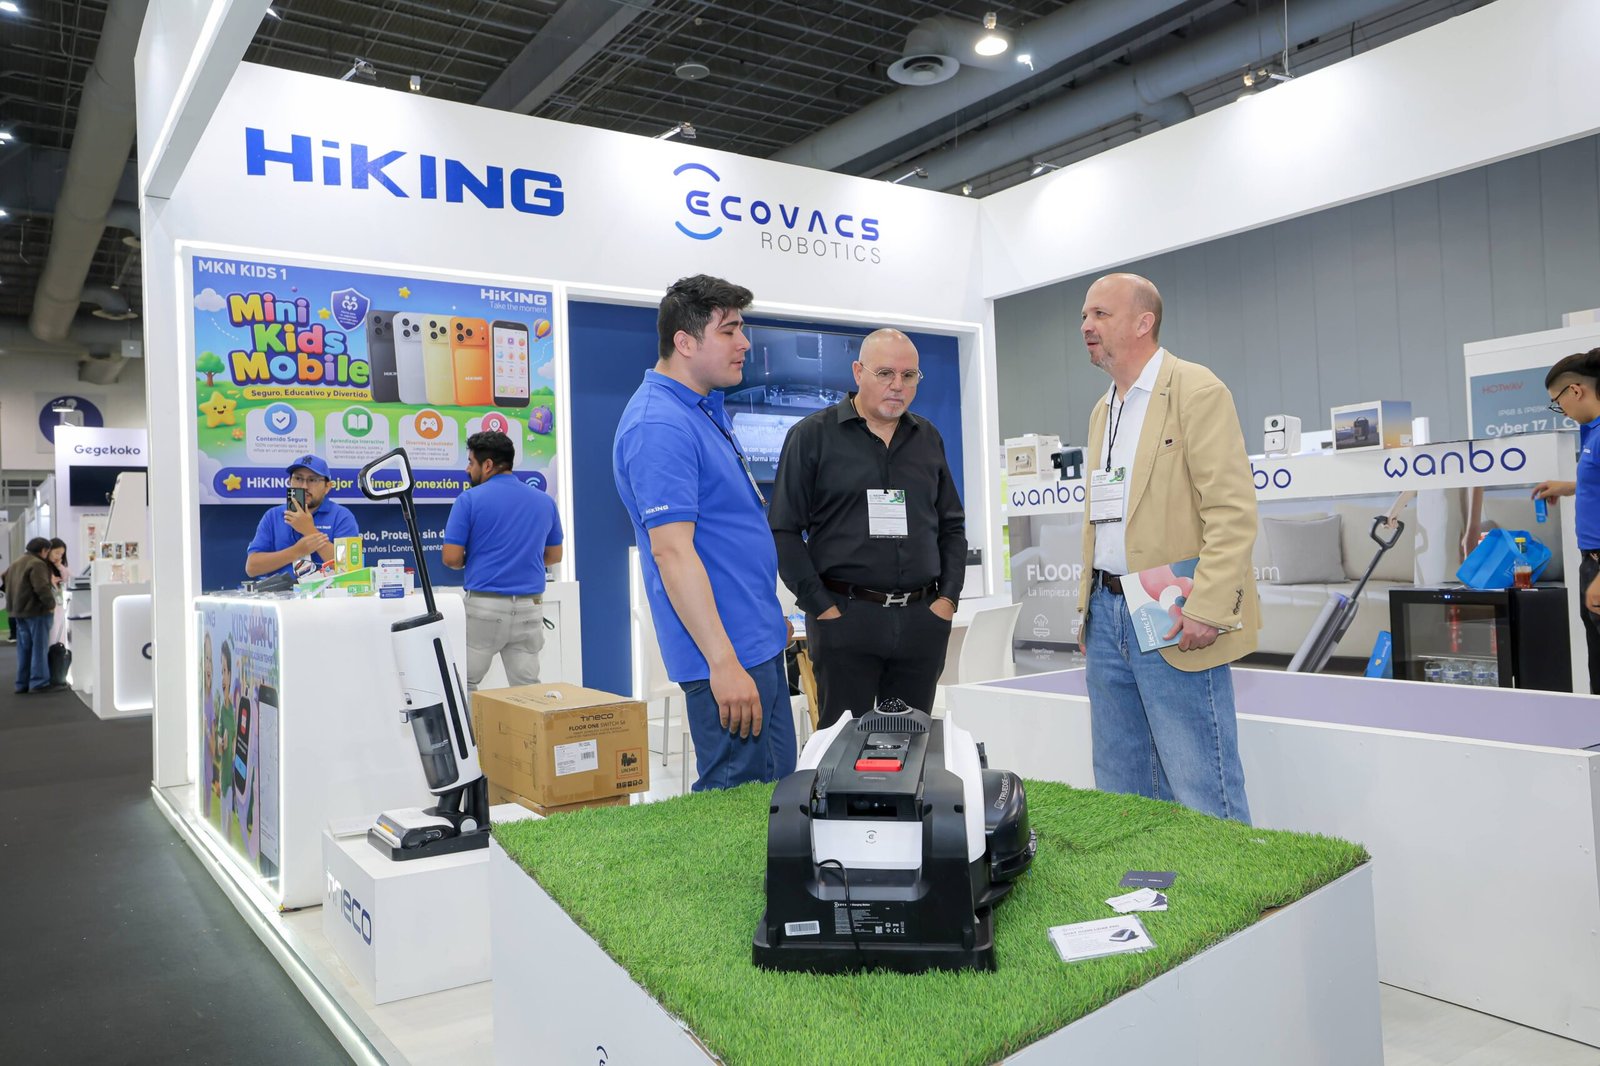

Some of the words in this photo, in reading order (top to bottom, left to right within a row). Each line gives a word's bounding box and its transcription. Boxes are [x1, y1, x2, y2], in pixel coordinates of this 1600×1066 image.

[686, 190, 880, 242] ECOVACS
[761, 231, 881, 264] ROBOTICS
[198, 260, 236, 275] MKN
[240, 265, 277, 279] KIDS
[280, 269, 287, 280] 1
[229, 292, 308, 324] Mini
[490, 301, 507, 310] Take
[507, 303, 519, 311] the
[519, 305, 547, 314] moment
[253, 323, 346, 354] Kids
[231, 351, 370, 384] Mobile
[285, 389, 325, 397] Educativo
[327, 390, 332, 398] y
[334, 389, 368, 398] Divertido
[1485, 422, 1529, 438] Cyber
[1531, 419, 1547, 431] 17
[74, 444, 141, 457] Gegekoko
[1384, 441, 1526, 478] wanbo
[331, 480, 354, 491] ejor
[415, 478, 460, 489] onexión
[1012, 481, 1085, 507] wanbo
[422, 529, 437, 539] sin
[368, 545, 387, 553] niños
[391, 544, 415, 552] Contro
[1026, 563, 1083, 581] FLOOR
[1028, 588, 1037, 597] La
[1040, 587, 1070, 598] limpieza
